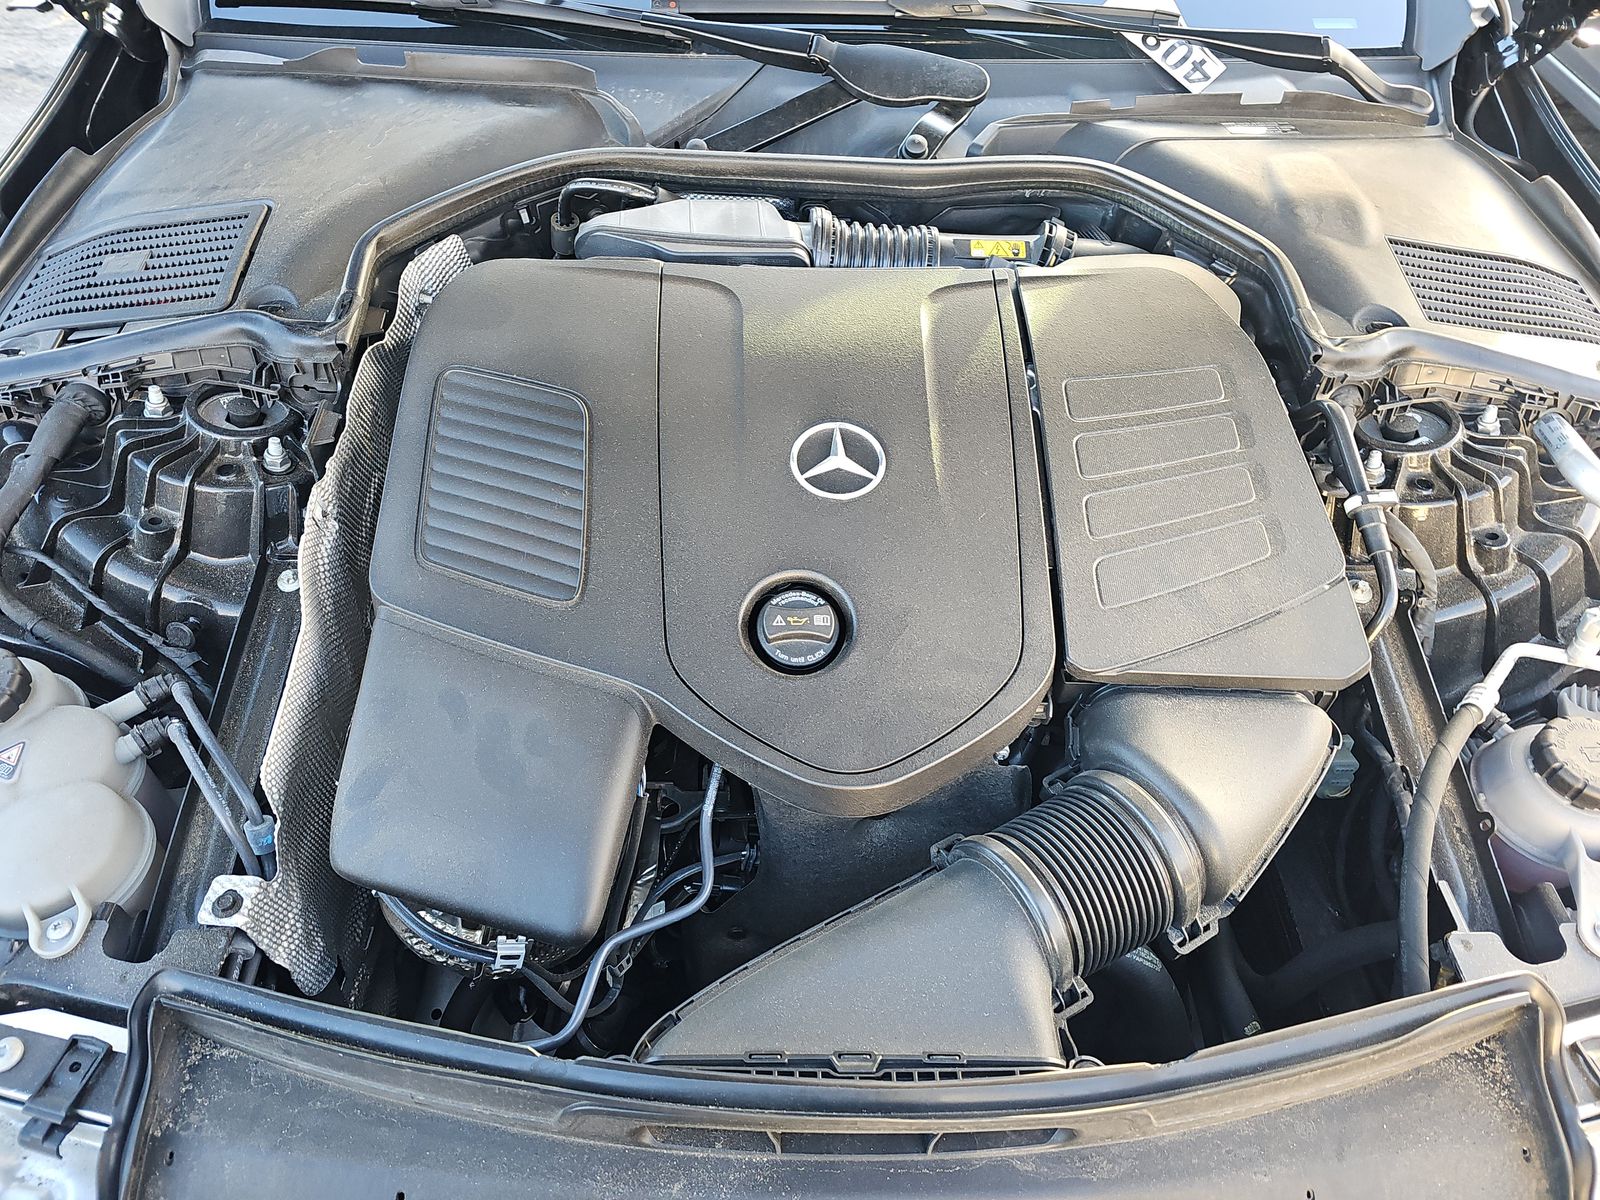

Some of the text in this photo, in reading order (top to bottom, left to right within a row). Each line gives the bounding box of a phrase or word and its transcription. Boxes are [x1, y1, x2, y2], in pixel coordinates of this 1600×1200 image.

[770, 591, 817, 605] Mercedes-Benz
[778, 596, 820, 606] recommended
[775, 649, 789, 661] Turn
[806, 649, 826, 662] CLICK
